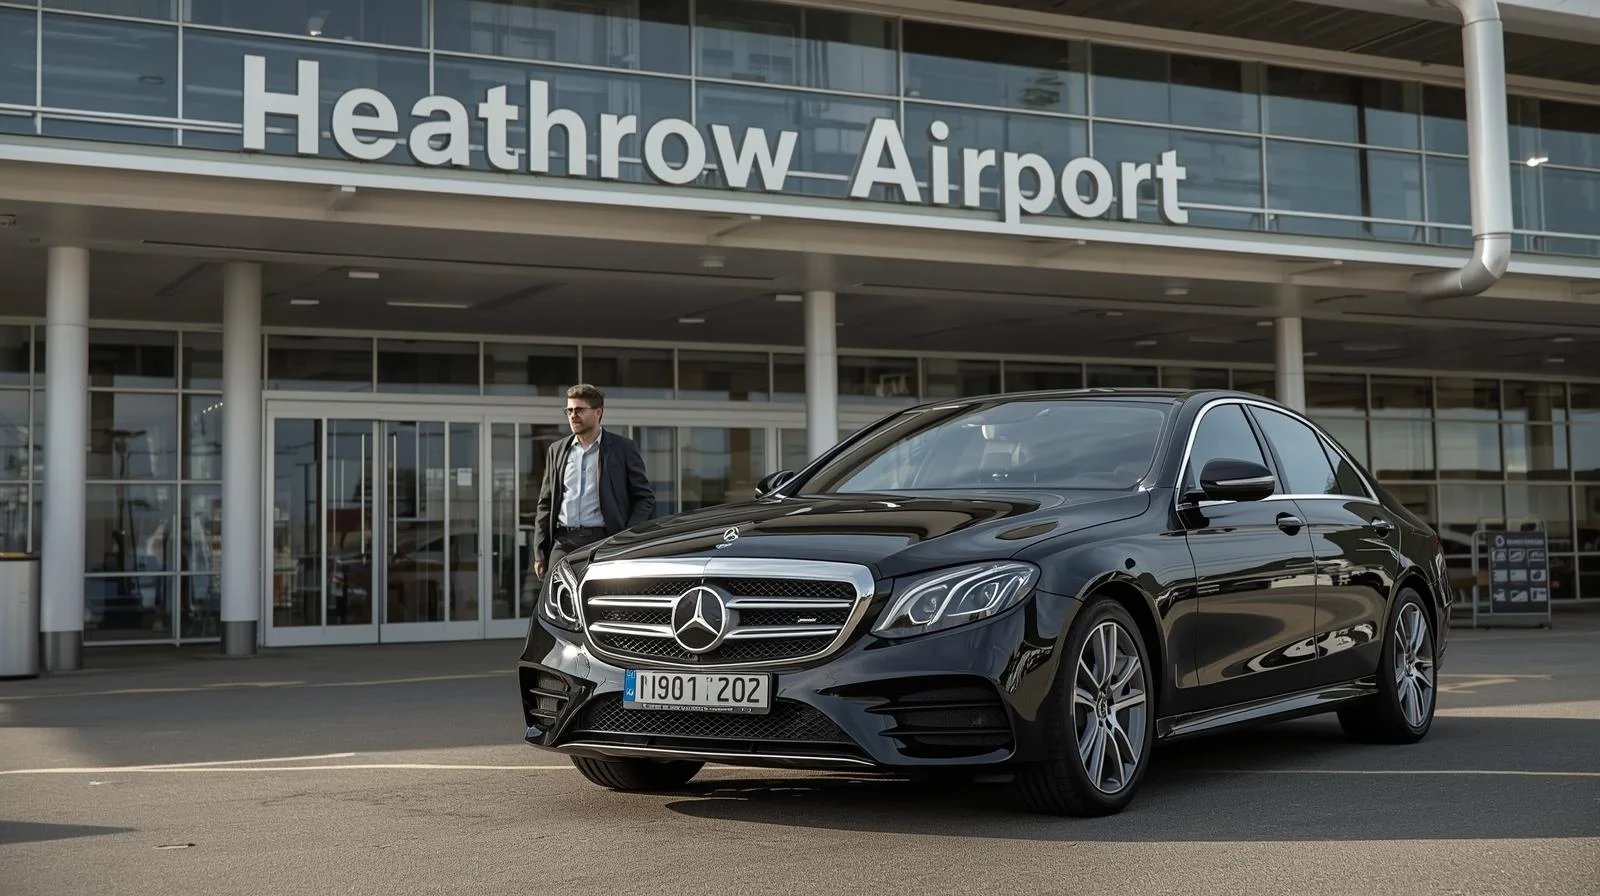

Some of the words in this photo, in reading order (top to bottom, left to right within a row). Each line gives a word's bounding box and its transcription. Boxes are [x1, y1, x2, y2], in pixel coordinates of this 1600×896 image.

[242, 54, 798, 191] Heathrow
[849, 117, 1189, 225] Airport
[717, 676, 761, 703] 202
